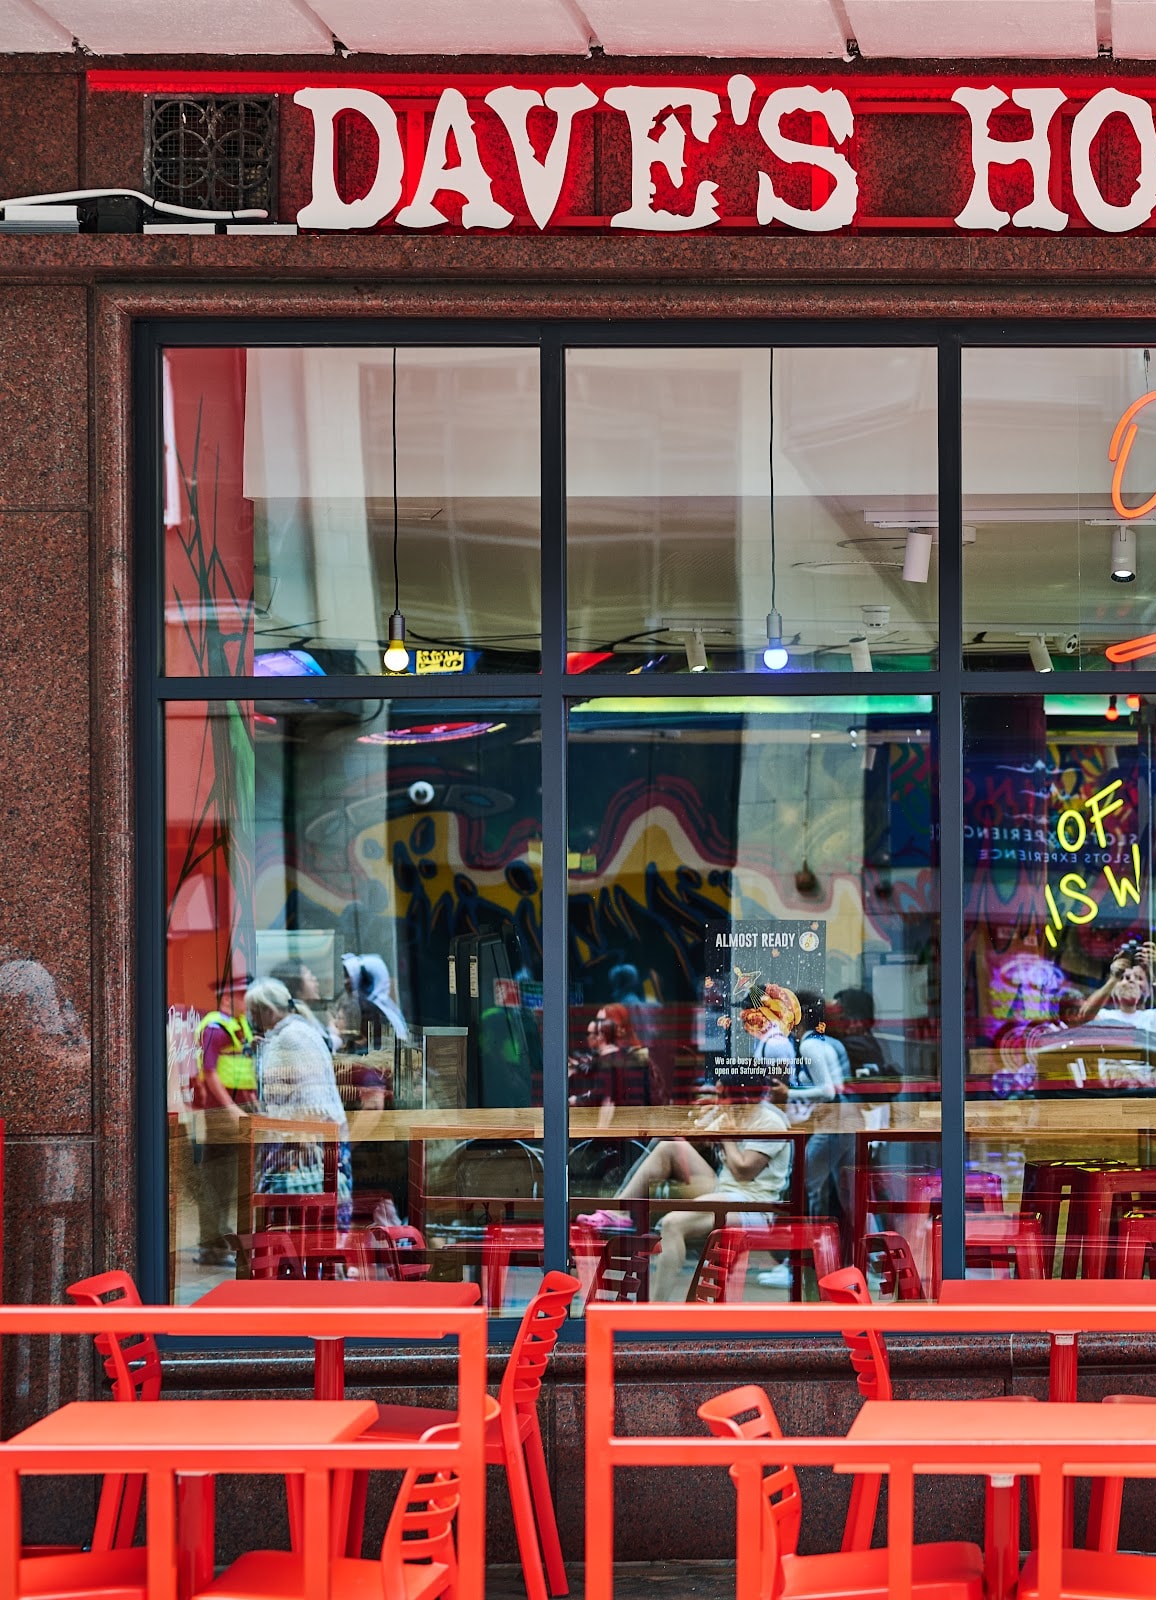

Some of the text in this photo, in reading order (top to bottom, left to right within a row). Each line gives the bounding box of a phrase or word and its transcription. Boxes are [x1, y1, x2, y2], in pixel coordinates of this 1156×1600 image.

[293, 74, 859, 232] DAVE'S
[1057, 779, 1124, 852] OF
[715, 933, 796, 948] ALMOST READY
[714, 1057, 725, 1065] We
[737, 1057, 752, 1067] busy
[776, 1057, 804, 1067] prepared
[805, 1057, 812, 1065] to
[714, 1068, 730, 1077] open
[739, 1067, 767, 1077] Saturday
[767, 1067, 782, 1075] 19th
[783, 1067, 796, 1077] July
